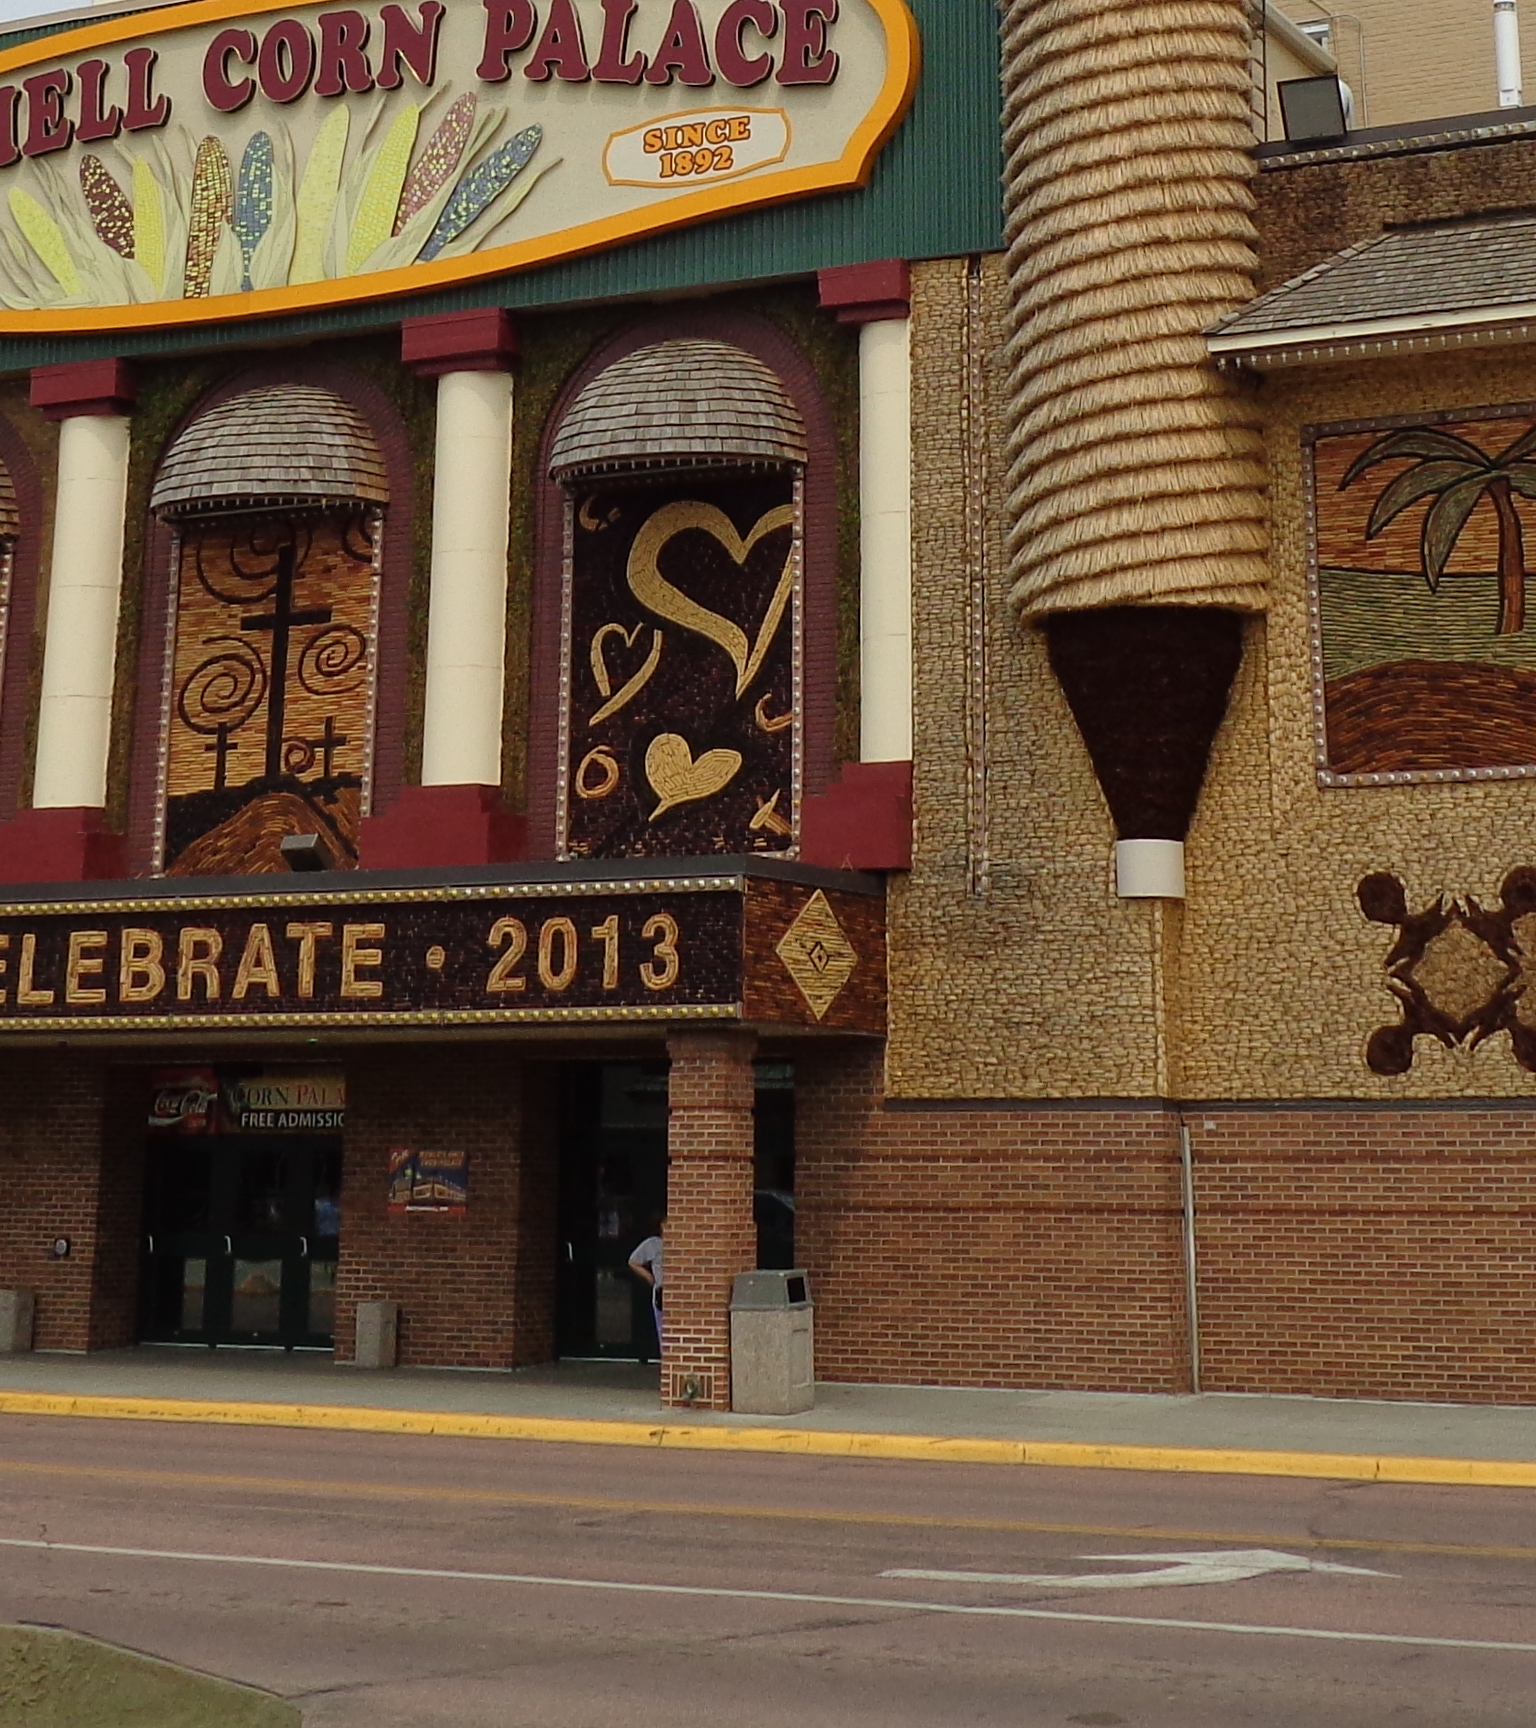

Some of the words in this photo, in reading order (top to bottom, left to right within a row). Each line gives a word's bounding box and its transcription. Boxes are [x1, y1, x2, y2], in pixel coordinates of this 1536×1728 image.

[202, 0, 446, 113] CORN
[642, 116, 751, 154] SINCE
[658, 147, 733, 179] 1892
[485, 912, 681, 992] 2013
[240, 1112, 275, 1128] FREE
